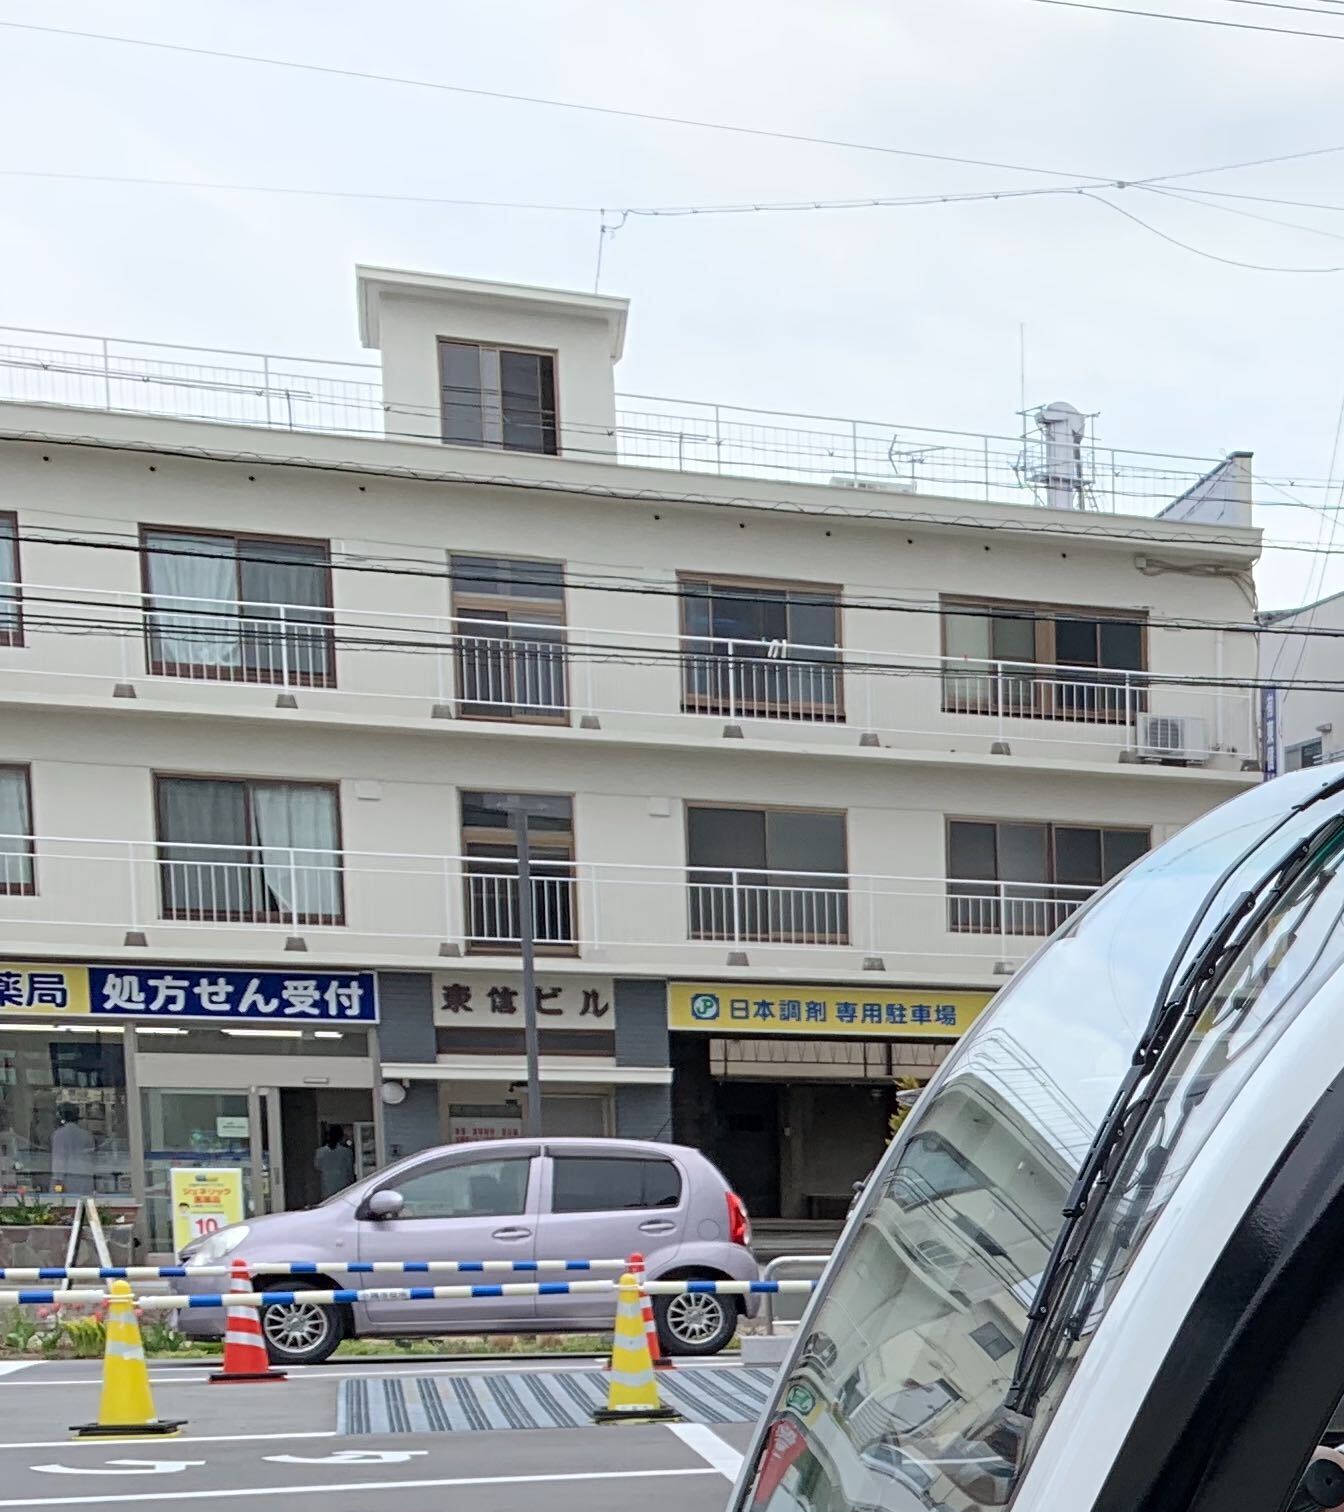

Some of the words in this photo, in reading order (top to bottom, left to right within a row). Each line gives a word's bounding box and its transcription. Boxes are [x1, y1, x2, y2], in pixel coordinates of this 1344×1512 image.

[101, 973, 365, 1017] 処方せん受付
[440, 983, 609, 1018] 東信ビル
[730, 999, 828, 1022] 日本調剤
[834, 1003, 957, 1026] 専用駐車場
